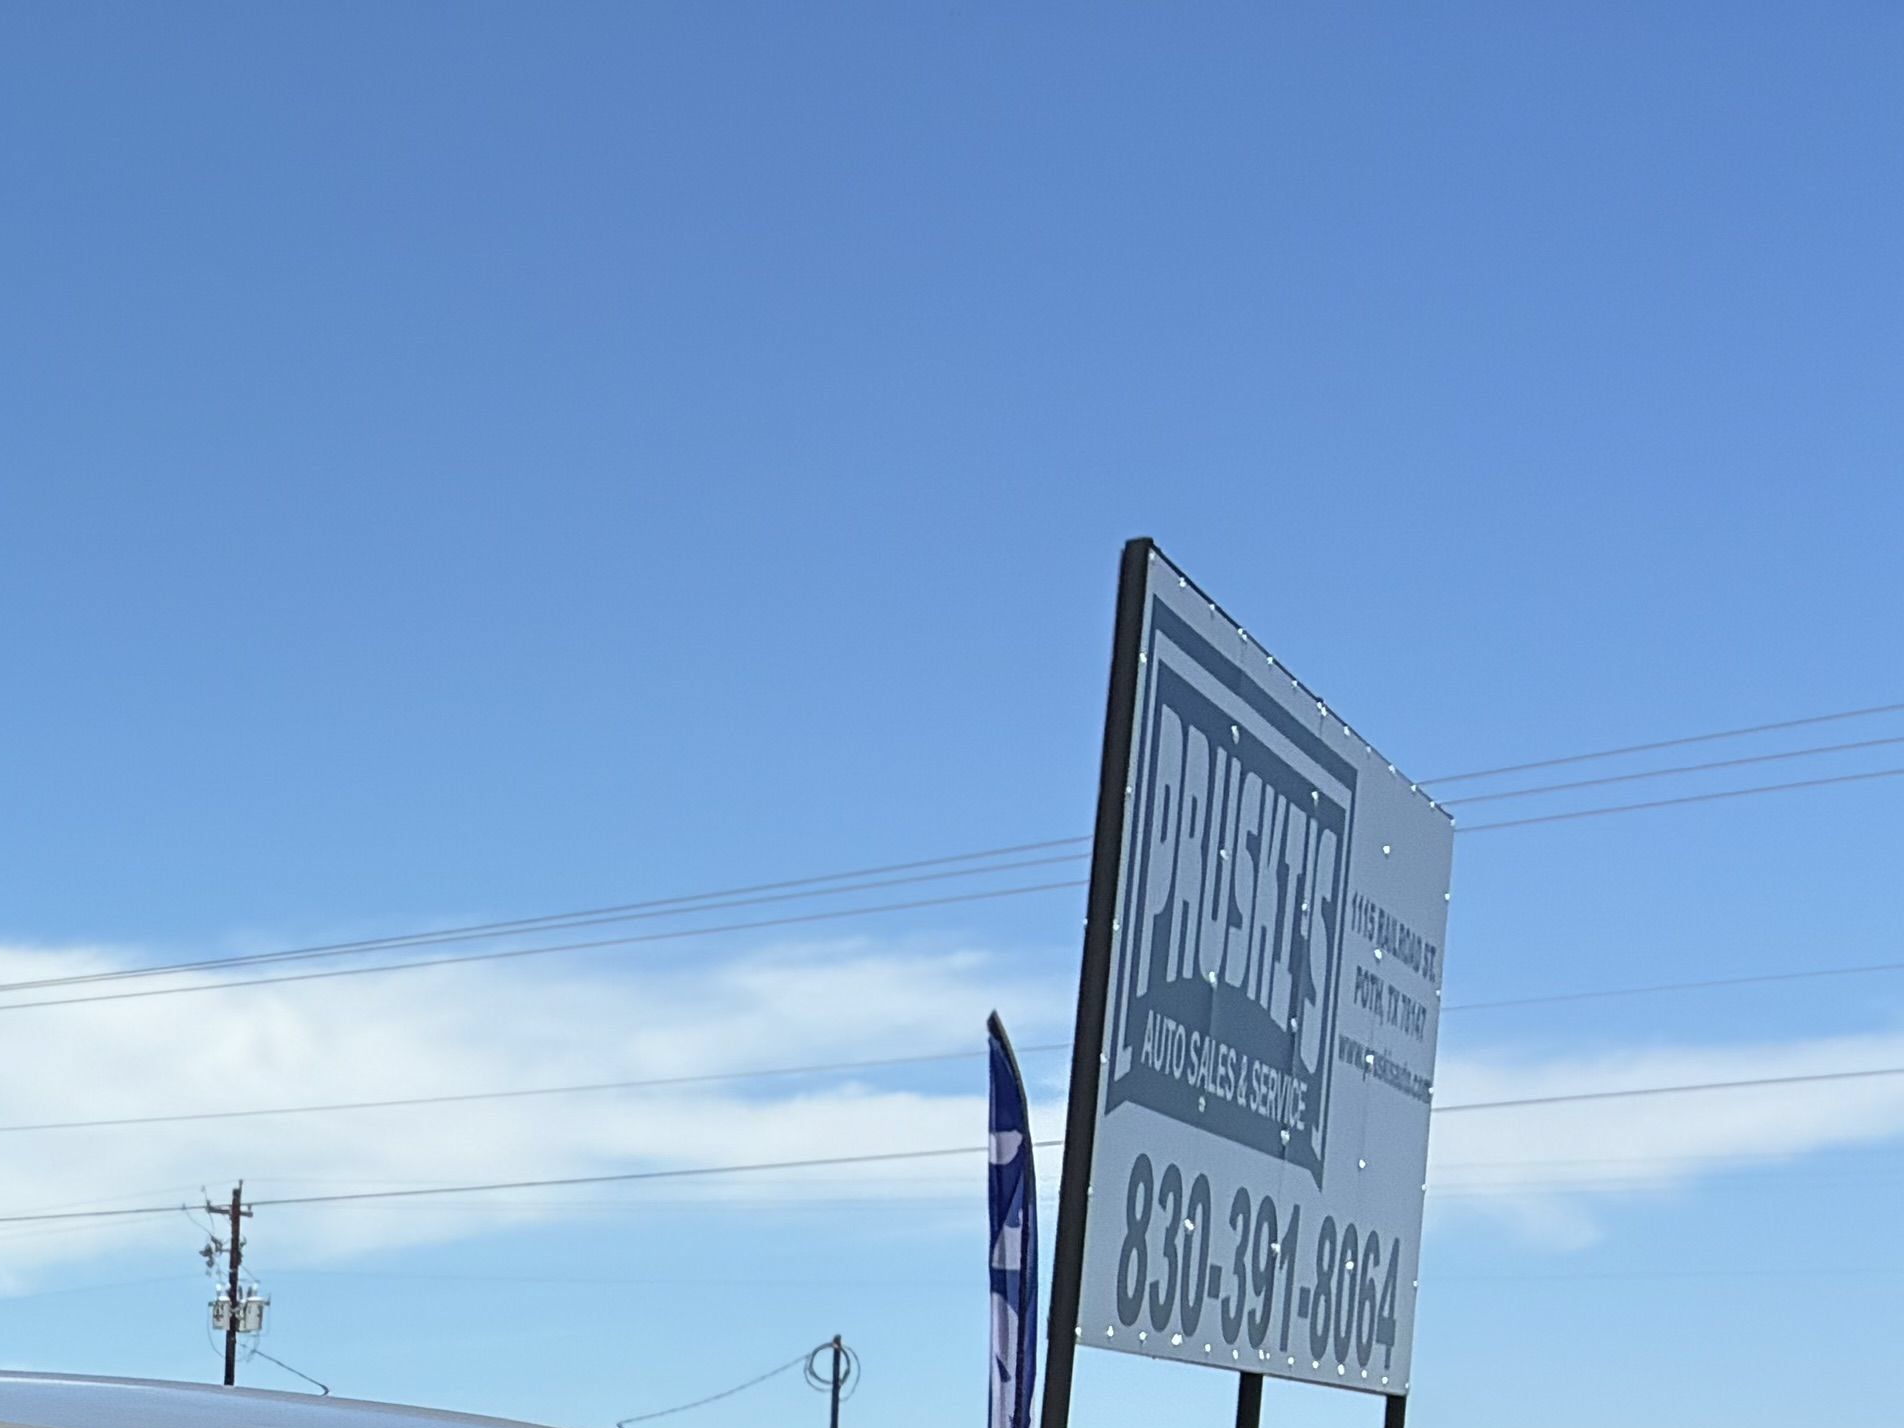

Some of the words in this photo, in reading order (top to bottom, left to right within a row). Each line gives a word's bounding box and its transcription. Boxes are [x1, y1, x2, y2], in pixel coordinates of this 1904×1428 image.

[1136, 704, 1337, 1074] PRUSKI'S
[1141, 1009, 1186, 1081] AUTO
[1187, 1033, 1236, 1102] SALES
[1237, 1054, 1248, 1108] &
[1248, 1060, 1307, 1131] SERVICE
[1116, 1152, 1400, 1370] 830-391-8064
